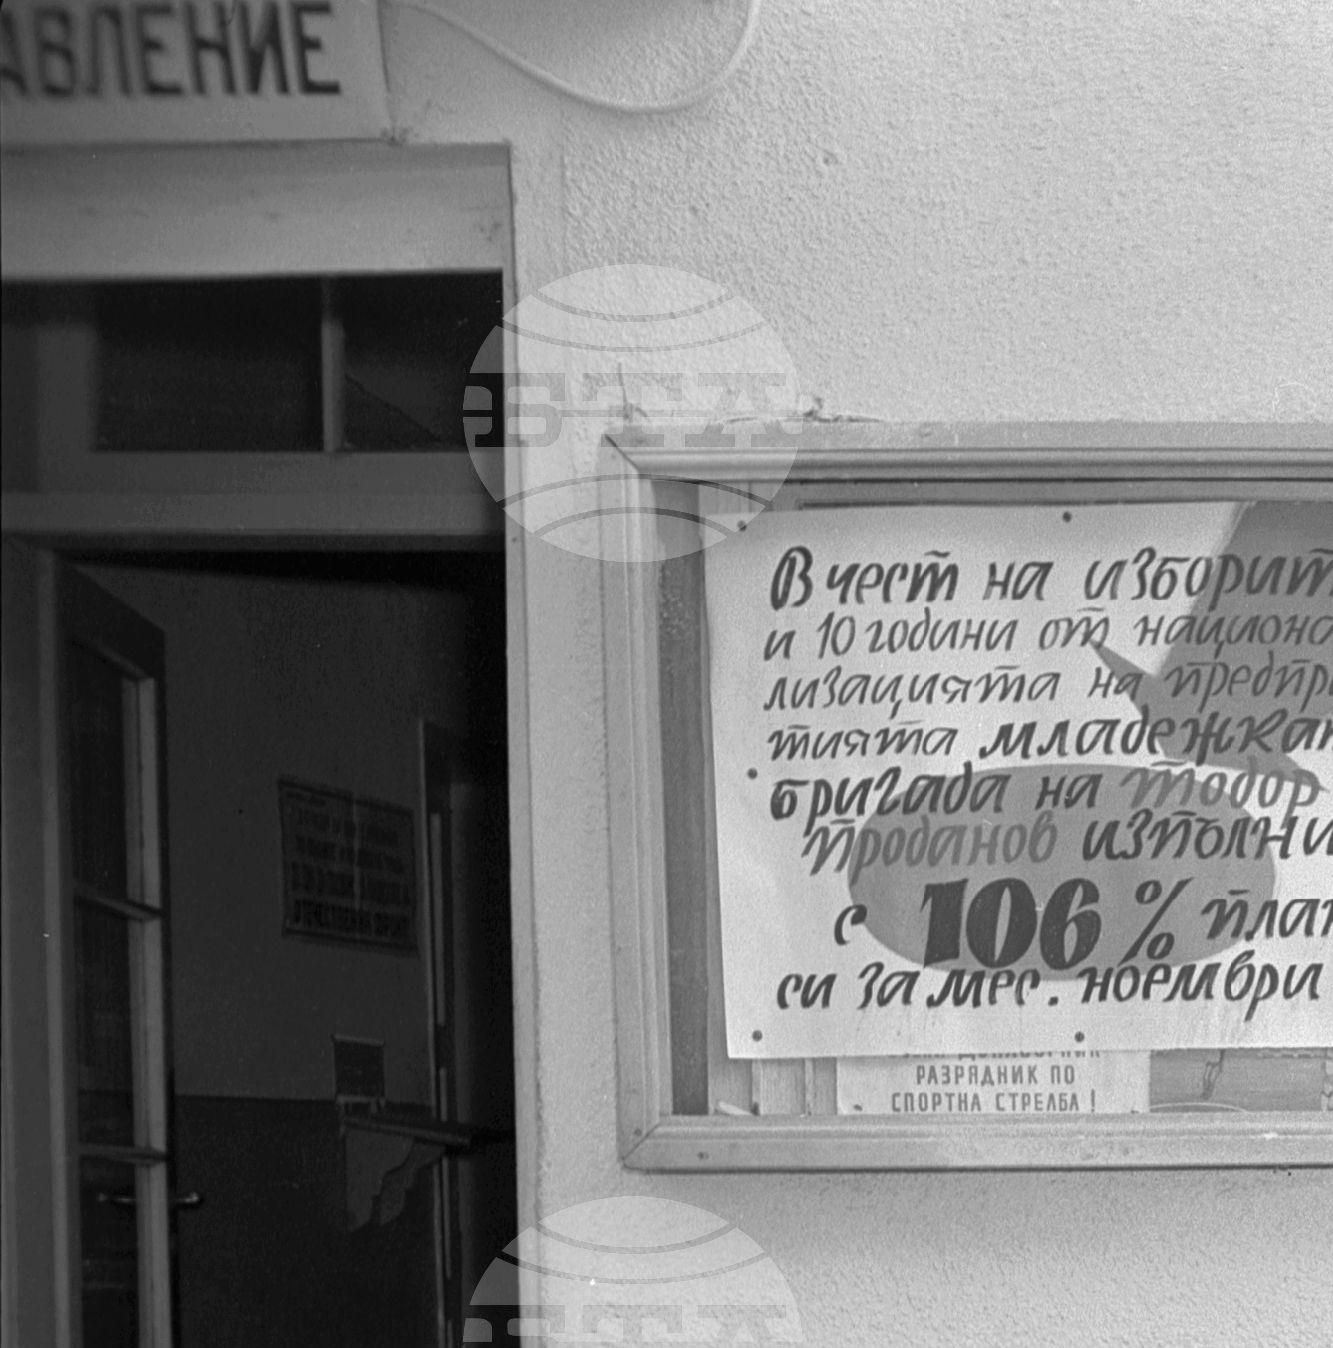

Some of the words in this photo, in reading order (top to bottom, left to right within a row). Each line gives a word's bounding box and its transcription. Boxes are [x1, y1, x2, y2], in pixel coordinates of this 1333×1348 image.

[771, 545, 813, 611] В
[826, 551, 960, 604] чест
[982, 561, 1054, 601] на
[763, 630, 796, 661] и
[817, 611, 856, 660] 10
[865, 606, 1019, 653] години
[1039, 606, 1110, 651] от
[763, 665, 1062, 719] лизацията
[1089, 666, 1144, 700] на
[766, 719, 959, 760] тията
[770, 760, 1012, 838] бригада
[1035, 773, 1104, 810] на
[834, 903, 867, 946] с
[919, 877, 1102, 971] 106
[777, 972, 837, 1010] си
[858, 961, 920, 1010] за
[926, 968, 1059, 1007] мес.
[1077, 949, 1323, 1022] ноември
[892, 1091, 982, 1112] СПОРТНА
[916, 1064, 1039, 1086] РАЗРЯДНИК
[1050, 1064, 1076, 1086] ПО
